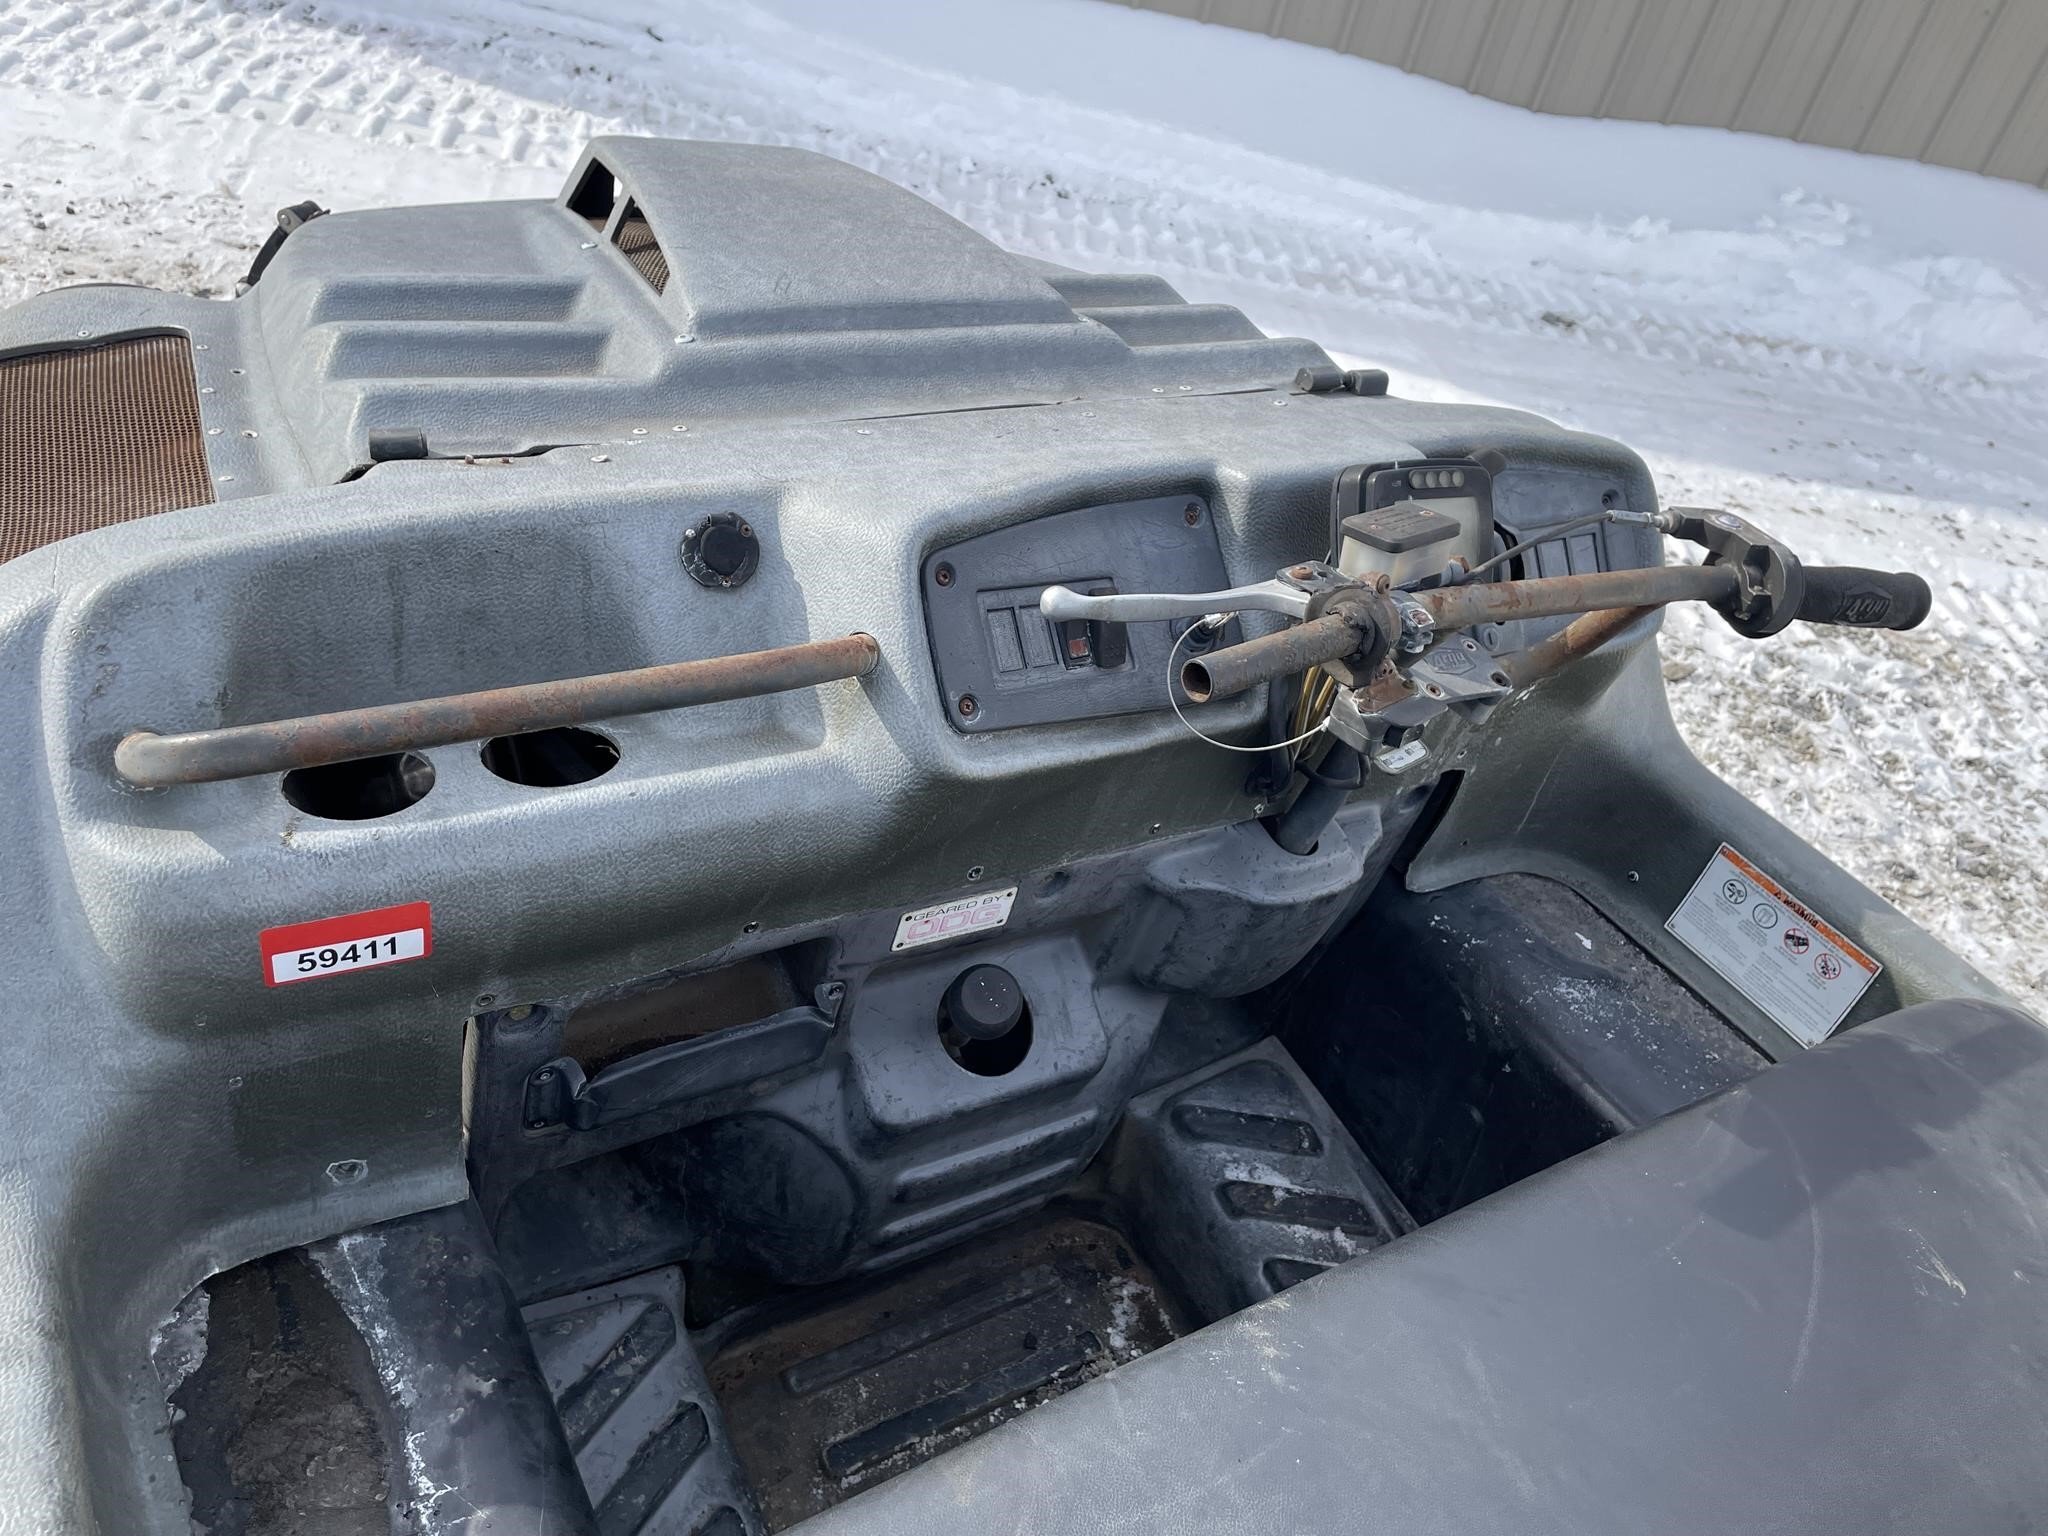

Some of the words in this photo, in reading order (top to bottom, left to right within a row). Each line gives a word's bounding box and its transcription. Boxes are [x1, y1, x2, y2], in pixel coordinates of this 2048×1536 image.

[913, 901, 978, 921] GEARED
[982, 894, 1004, 905] BY
[1783, 897, 1819, 928] WARNING
[297, 936, 397, 972] 59411
